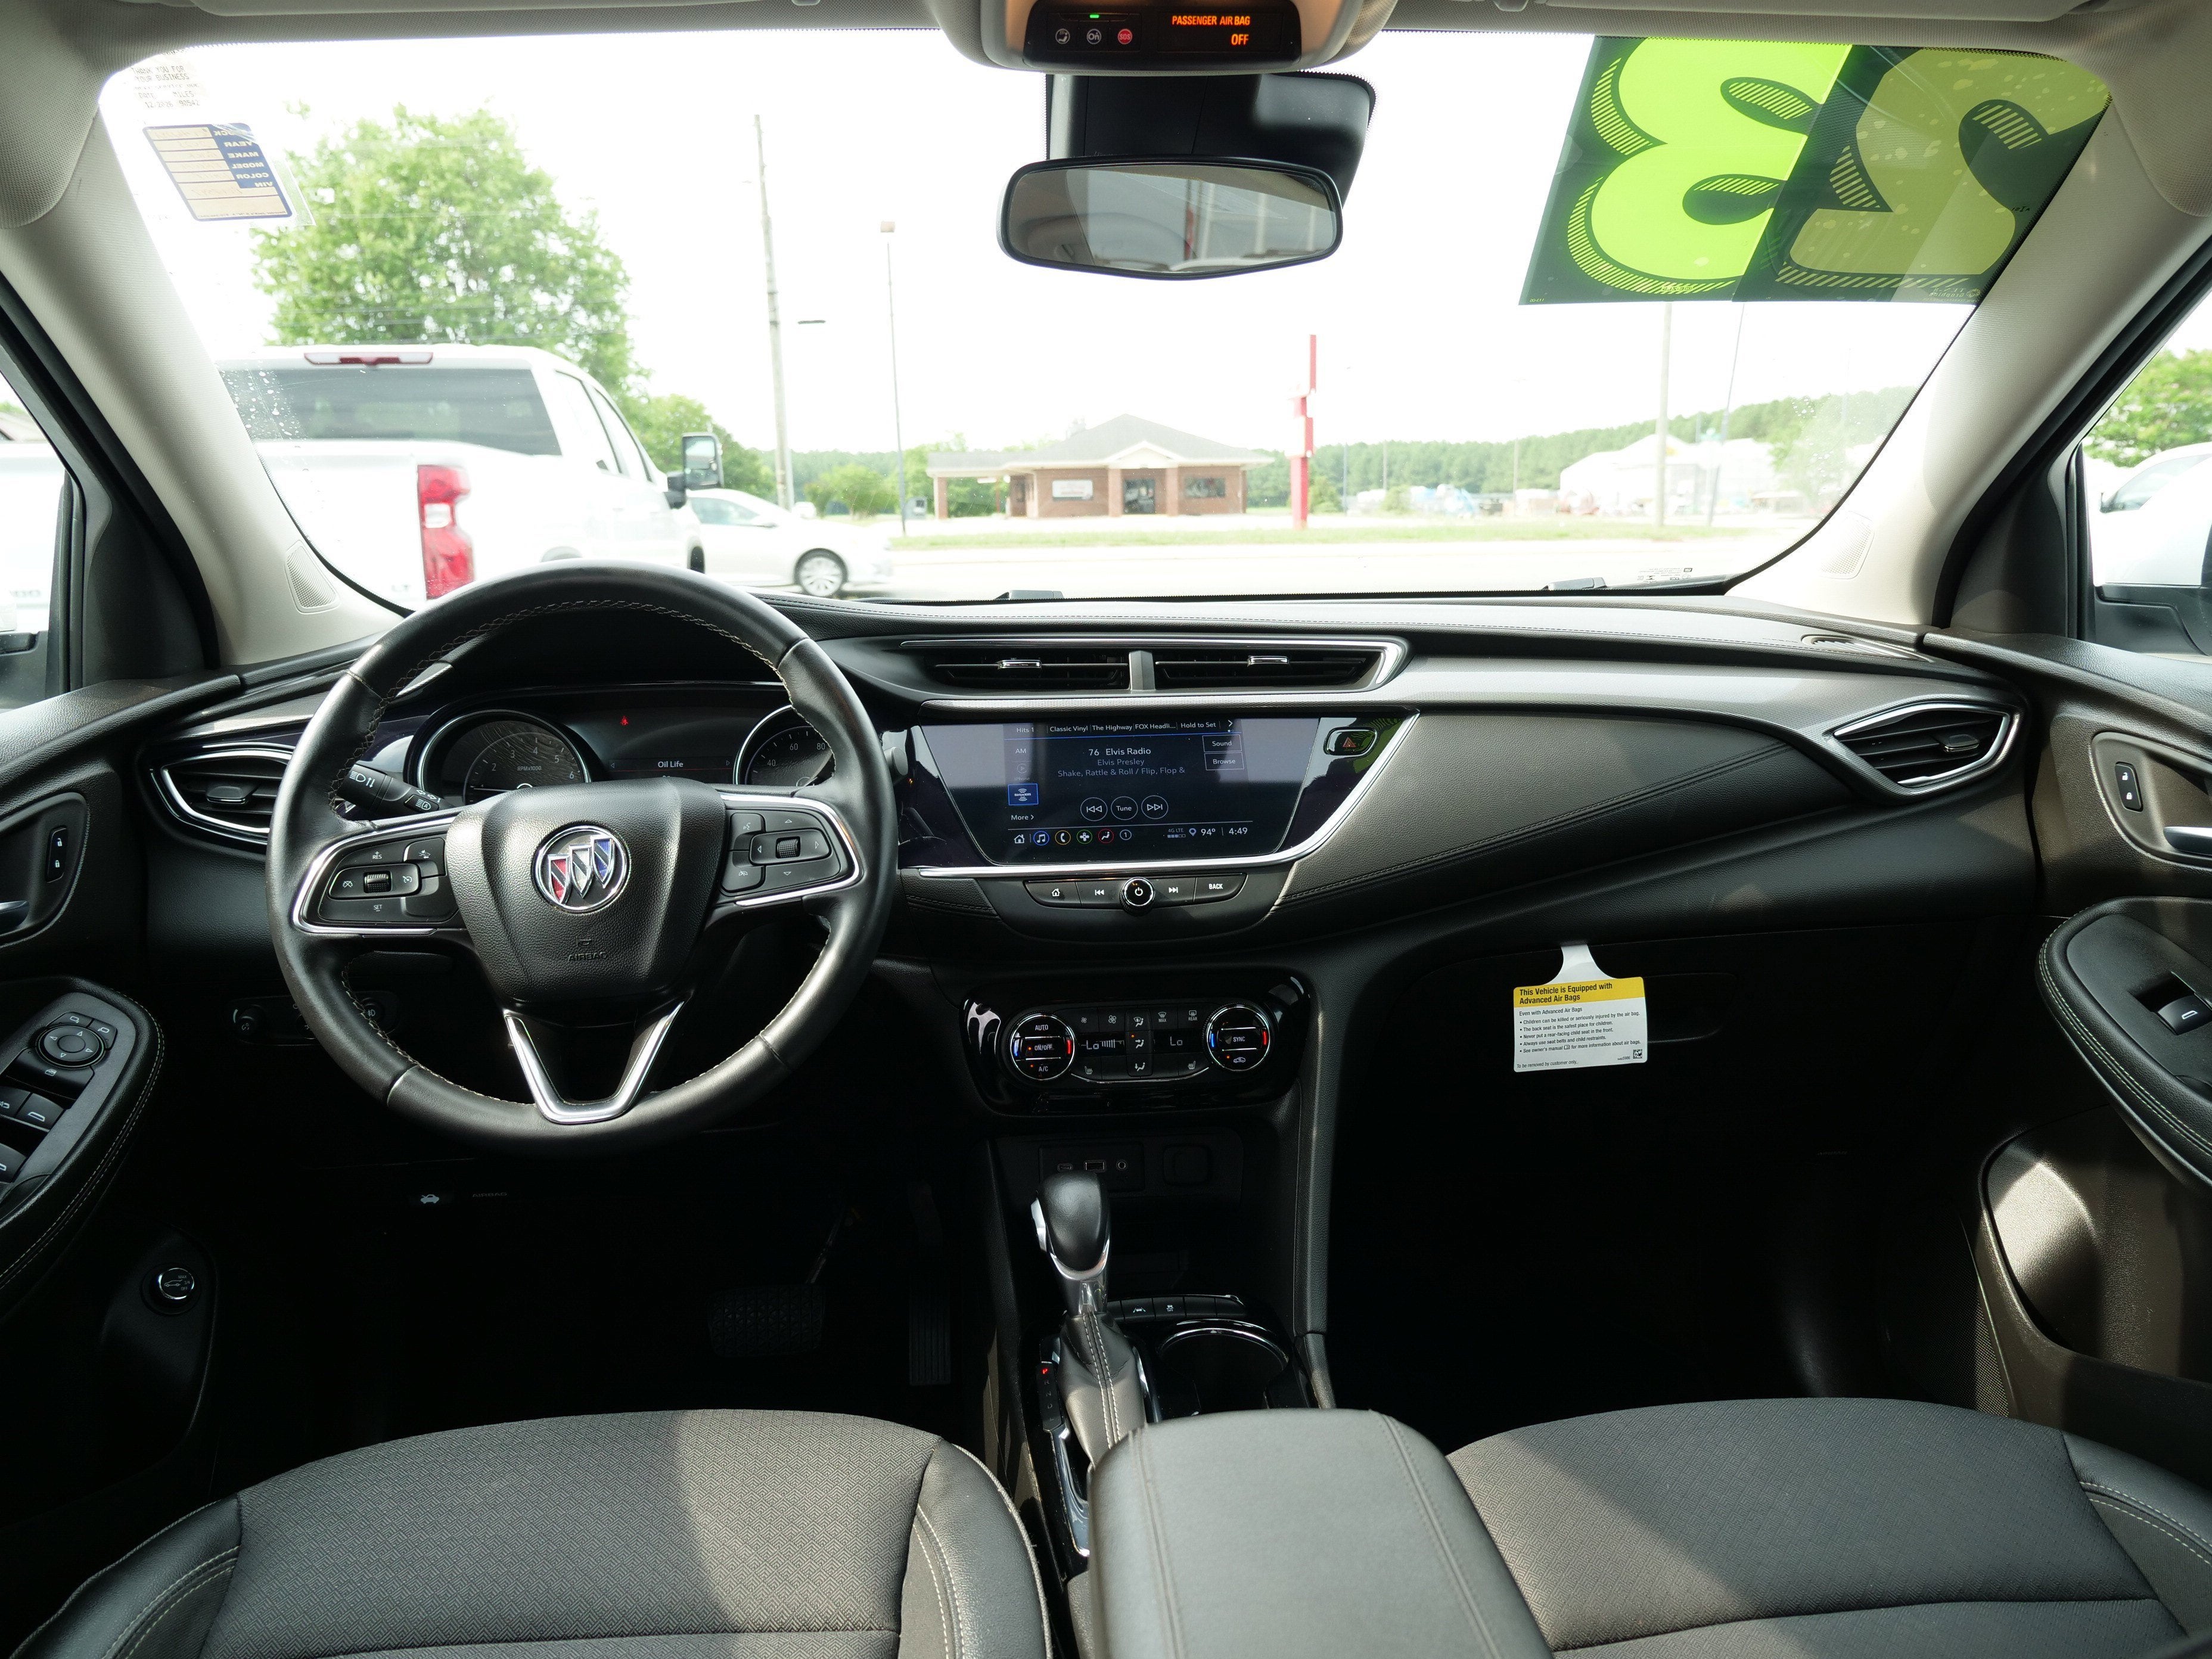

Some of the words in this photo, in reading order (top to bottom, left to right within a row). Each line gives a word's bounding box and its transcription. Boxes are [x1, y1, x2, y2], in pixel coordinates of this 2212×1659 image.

[1172, 15, 1217, 26] PASSENGER
[1220, 16, 1233, 26] AIR
[1234, 15, 1251, 26] BAG
[1231, 34, 1249, 45] OFF
[511, 750, 515, 759] 3
[533, 747, 538, 755] 4
[1106, 747, 1125, 756] Elvis
[555, 755, 560, 763] 5
[492, 763, 496, 771] 2
[1160, 767, 1177, 775] Flop
[569, 771, 574, 779] 6
[1535, 987, 1559, 995] Vehicle
[1568, 984, 1597, 993] Equipped
[1519, 996, 1552, 1005] Advanced
[1086, 1040, 1099, 1050] Lo
[1170, 1036, 1183, 1046] Lo
